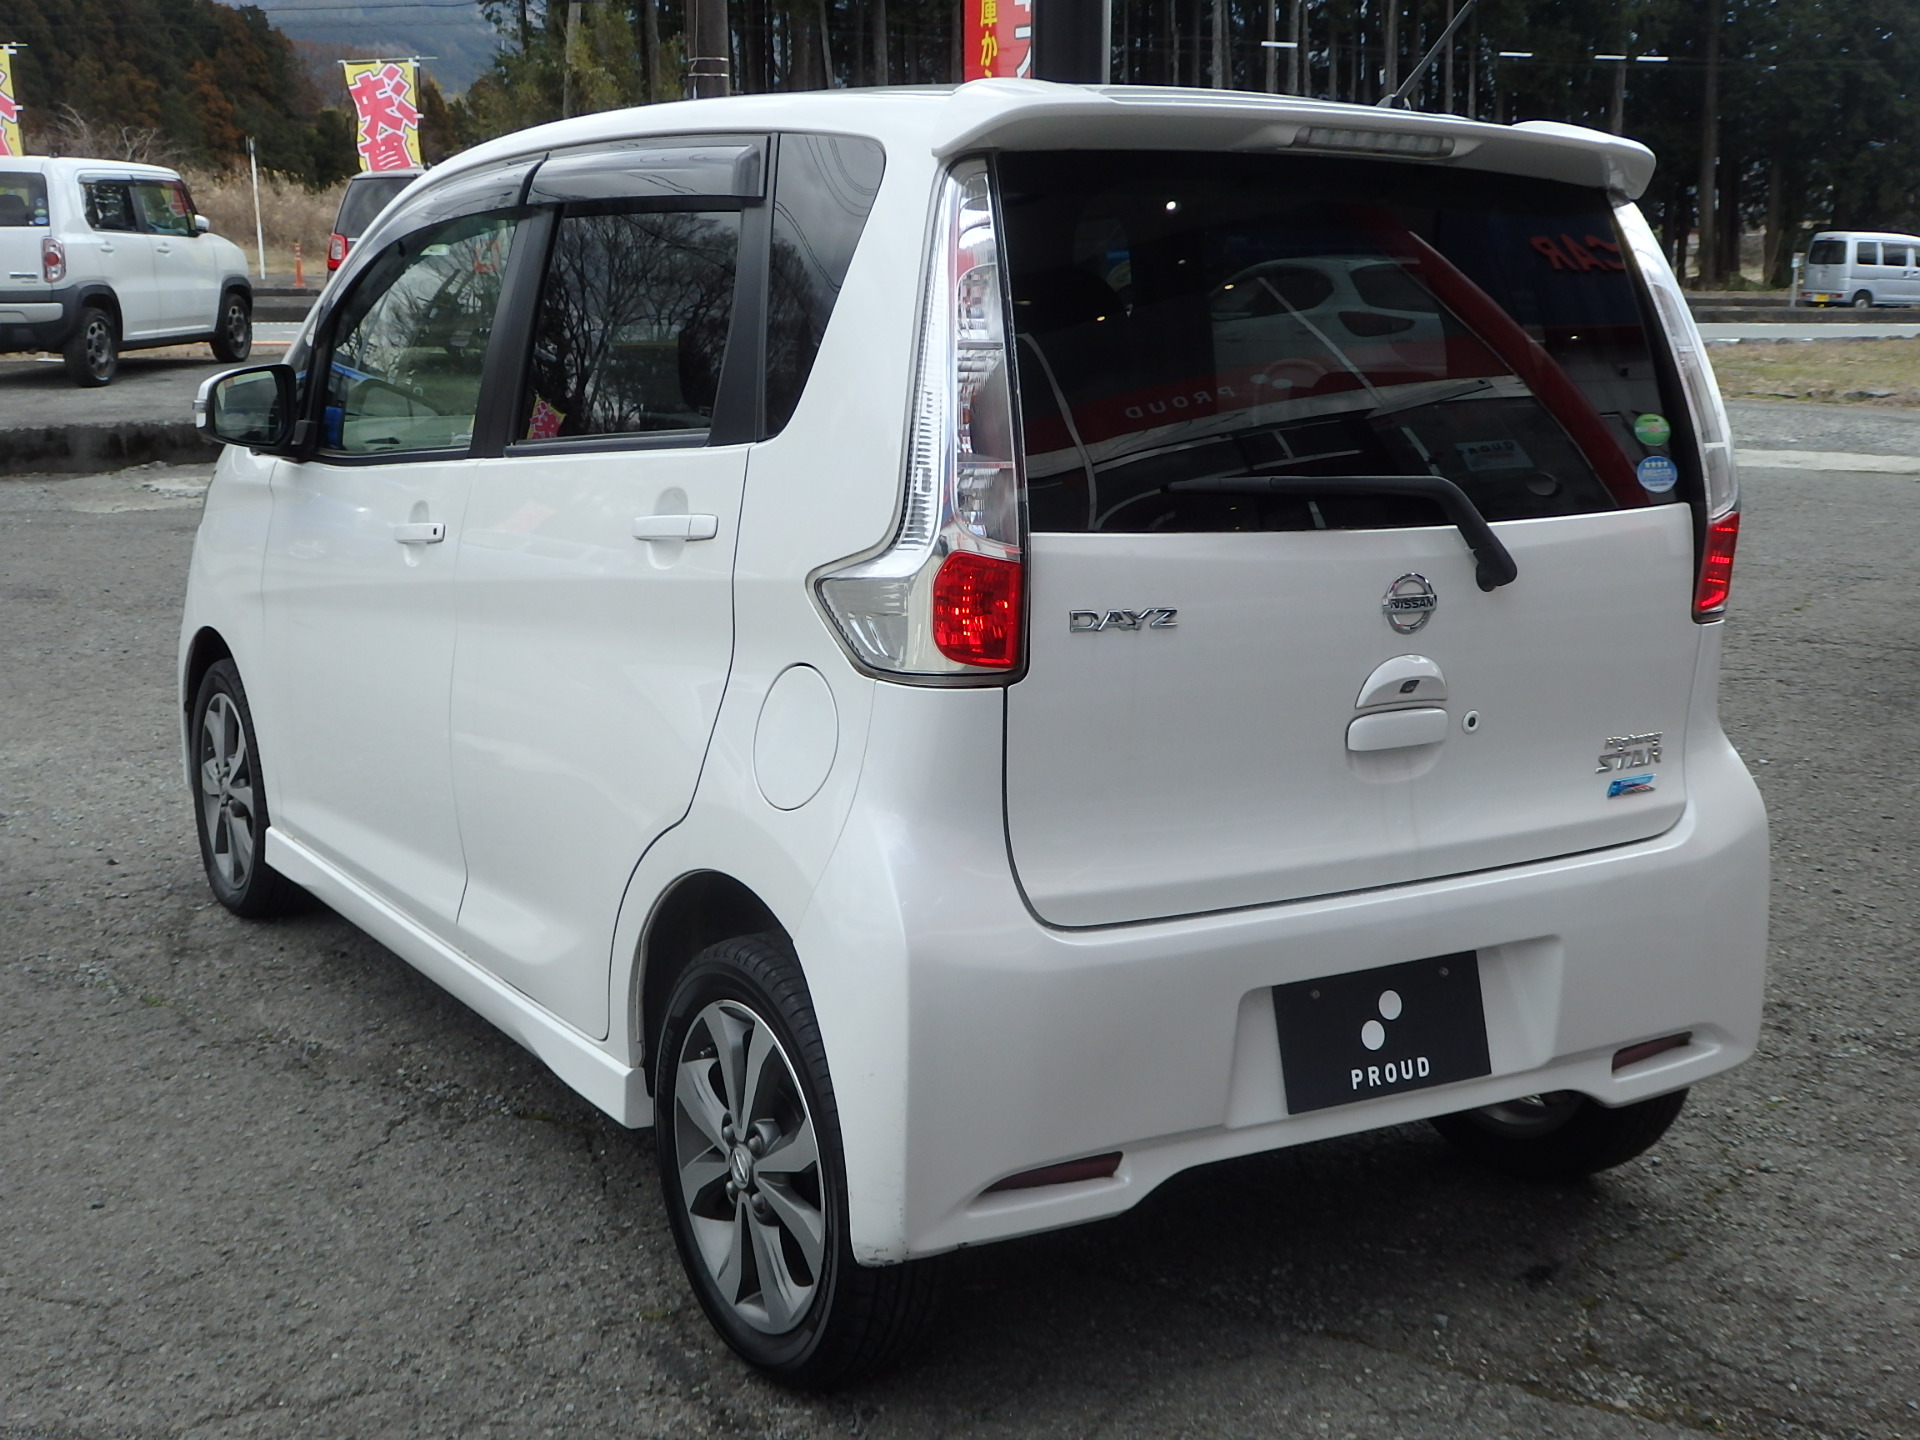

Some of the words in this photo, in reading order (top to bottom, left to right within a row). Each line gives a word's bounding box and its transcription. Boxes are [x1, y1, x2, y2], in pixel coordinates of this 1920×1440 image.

[1390, 597, 1434, 609] NISSAN
[1069, 607, 1178, 633] DAYZ
[1595, 746, 1663, 774] STAR
[1351, 1056, 1430, 1090] PROUD
